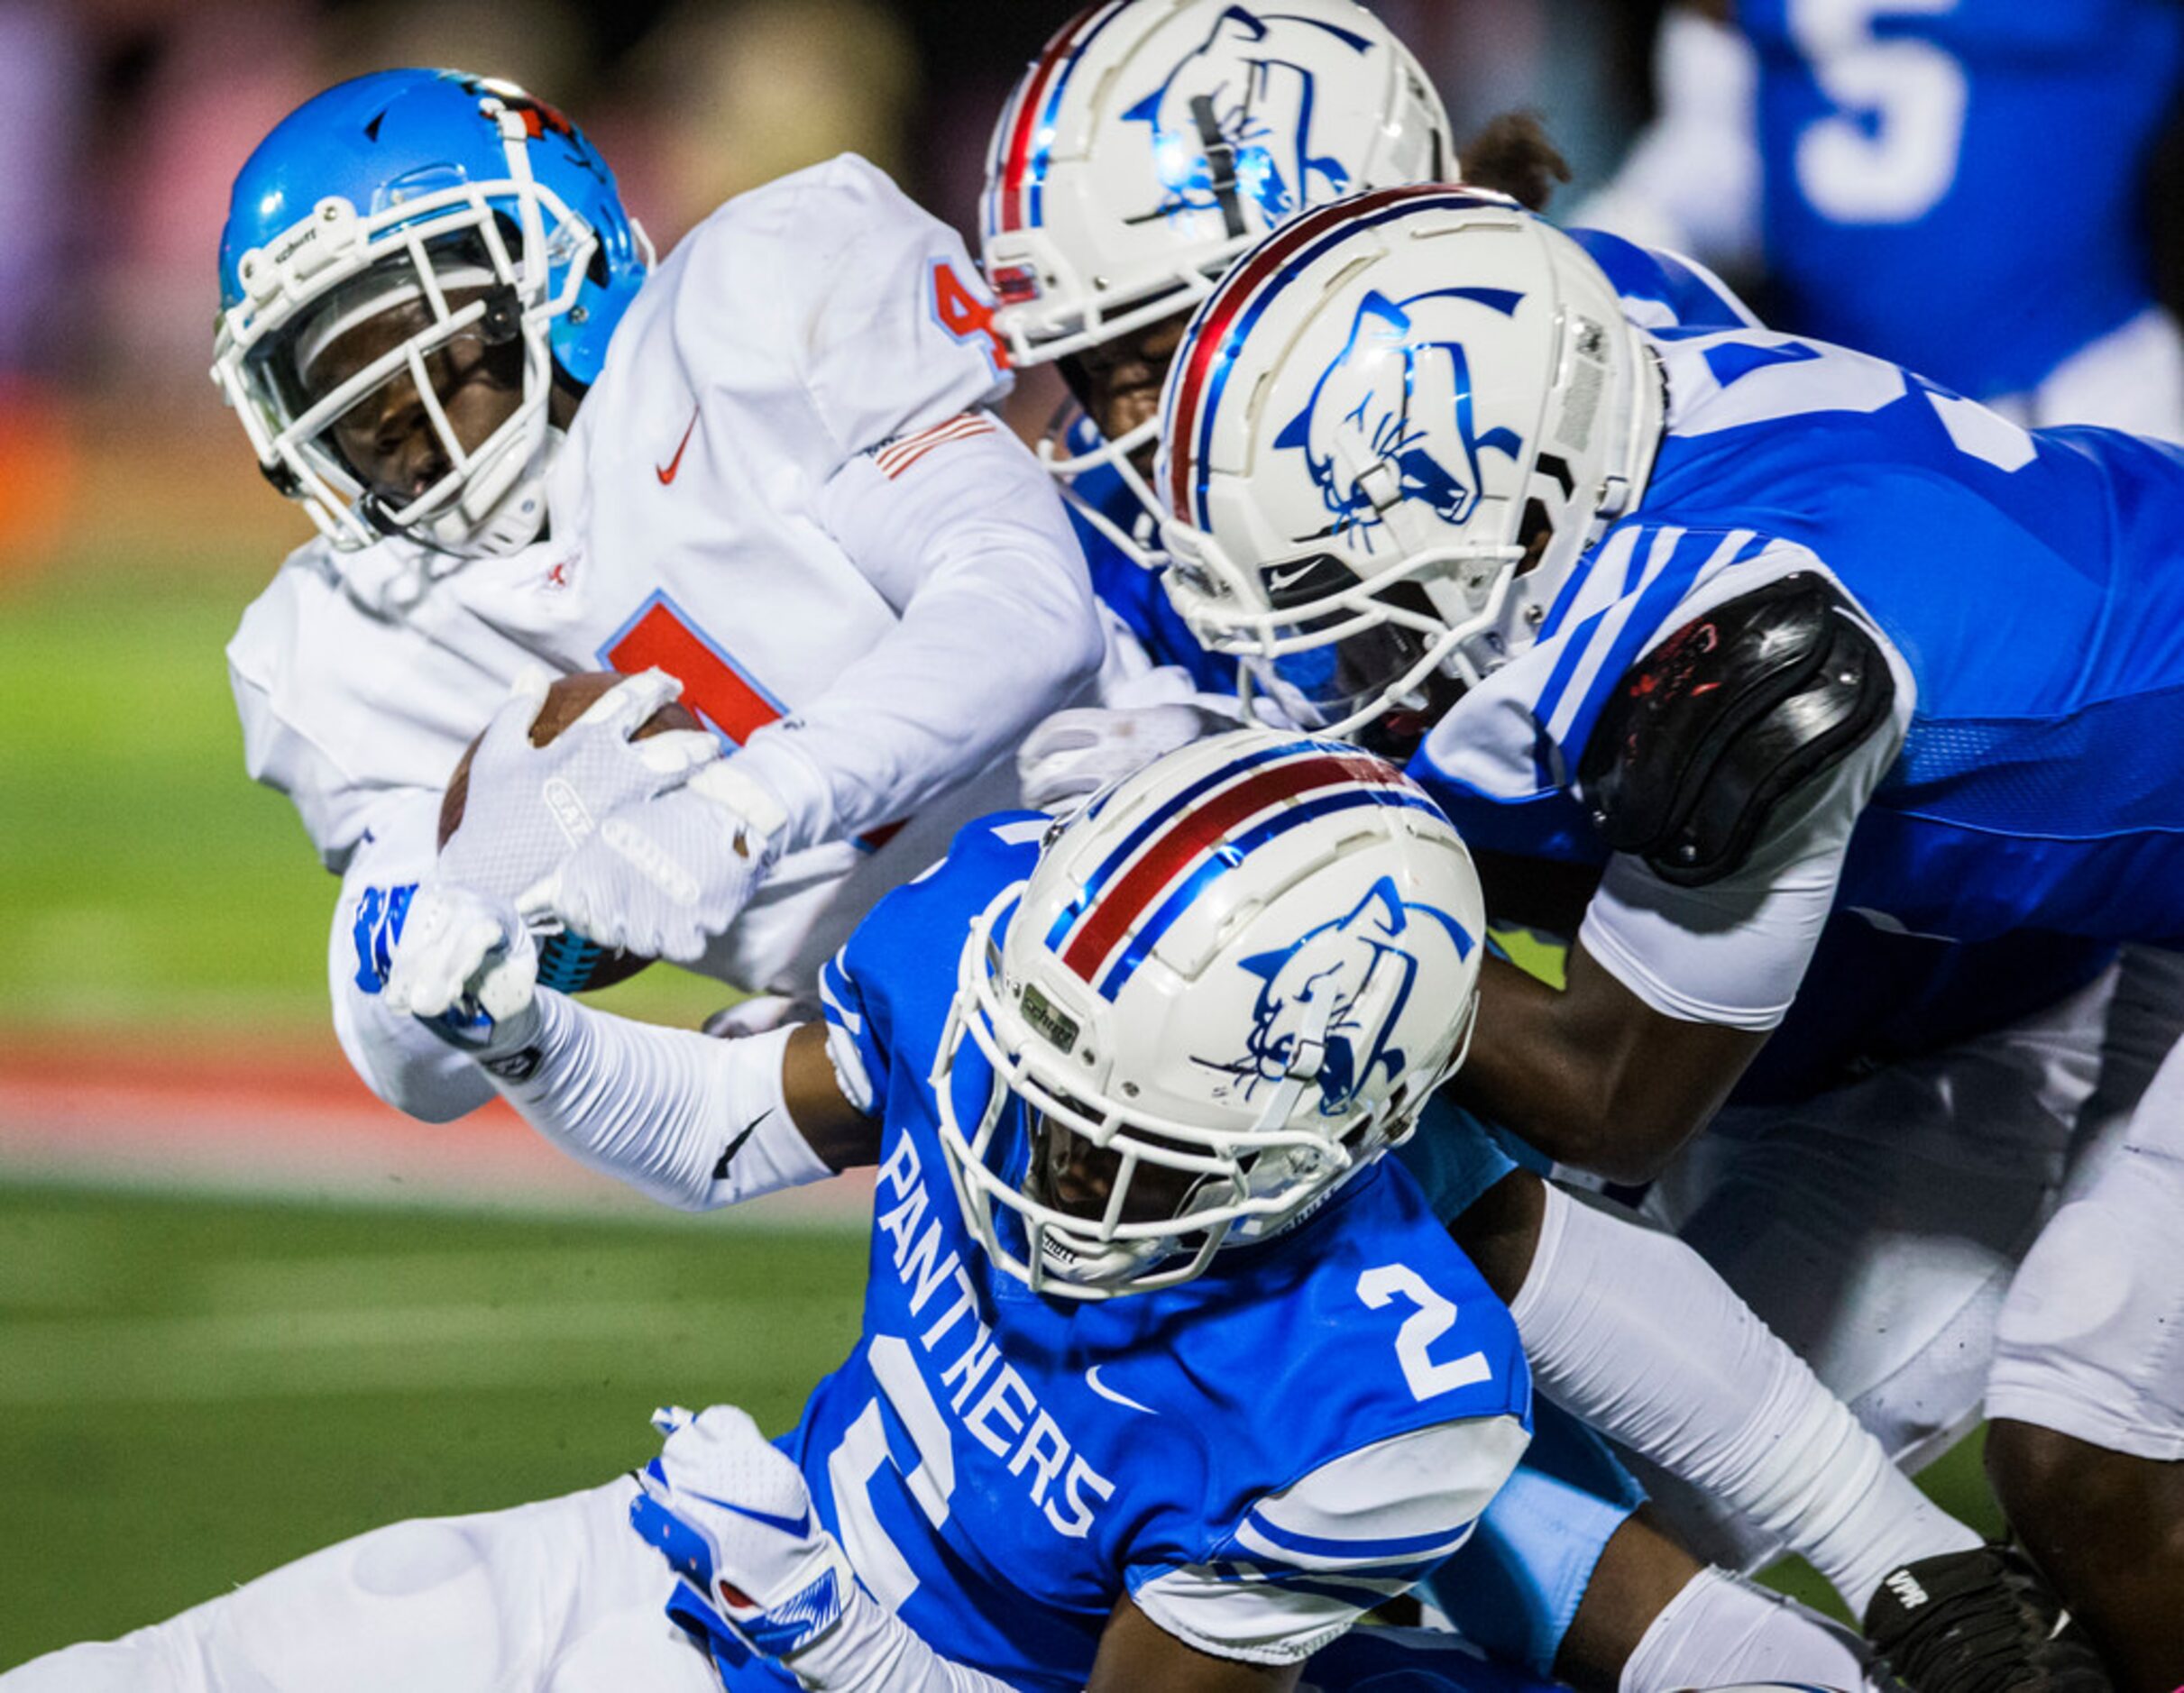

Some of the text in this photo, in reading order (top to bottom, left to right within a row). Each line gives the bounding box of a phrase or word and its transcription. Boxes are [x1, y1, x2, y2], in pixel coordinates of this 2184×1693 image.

[1787, 0, 1969, 224] 5
[876, 1128, 1116, 1538] PANTHERS
[1354, 1262, 1492, 1402] 2
[828, 1334, 957, 1613] 2
